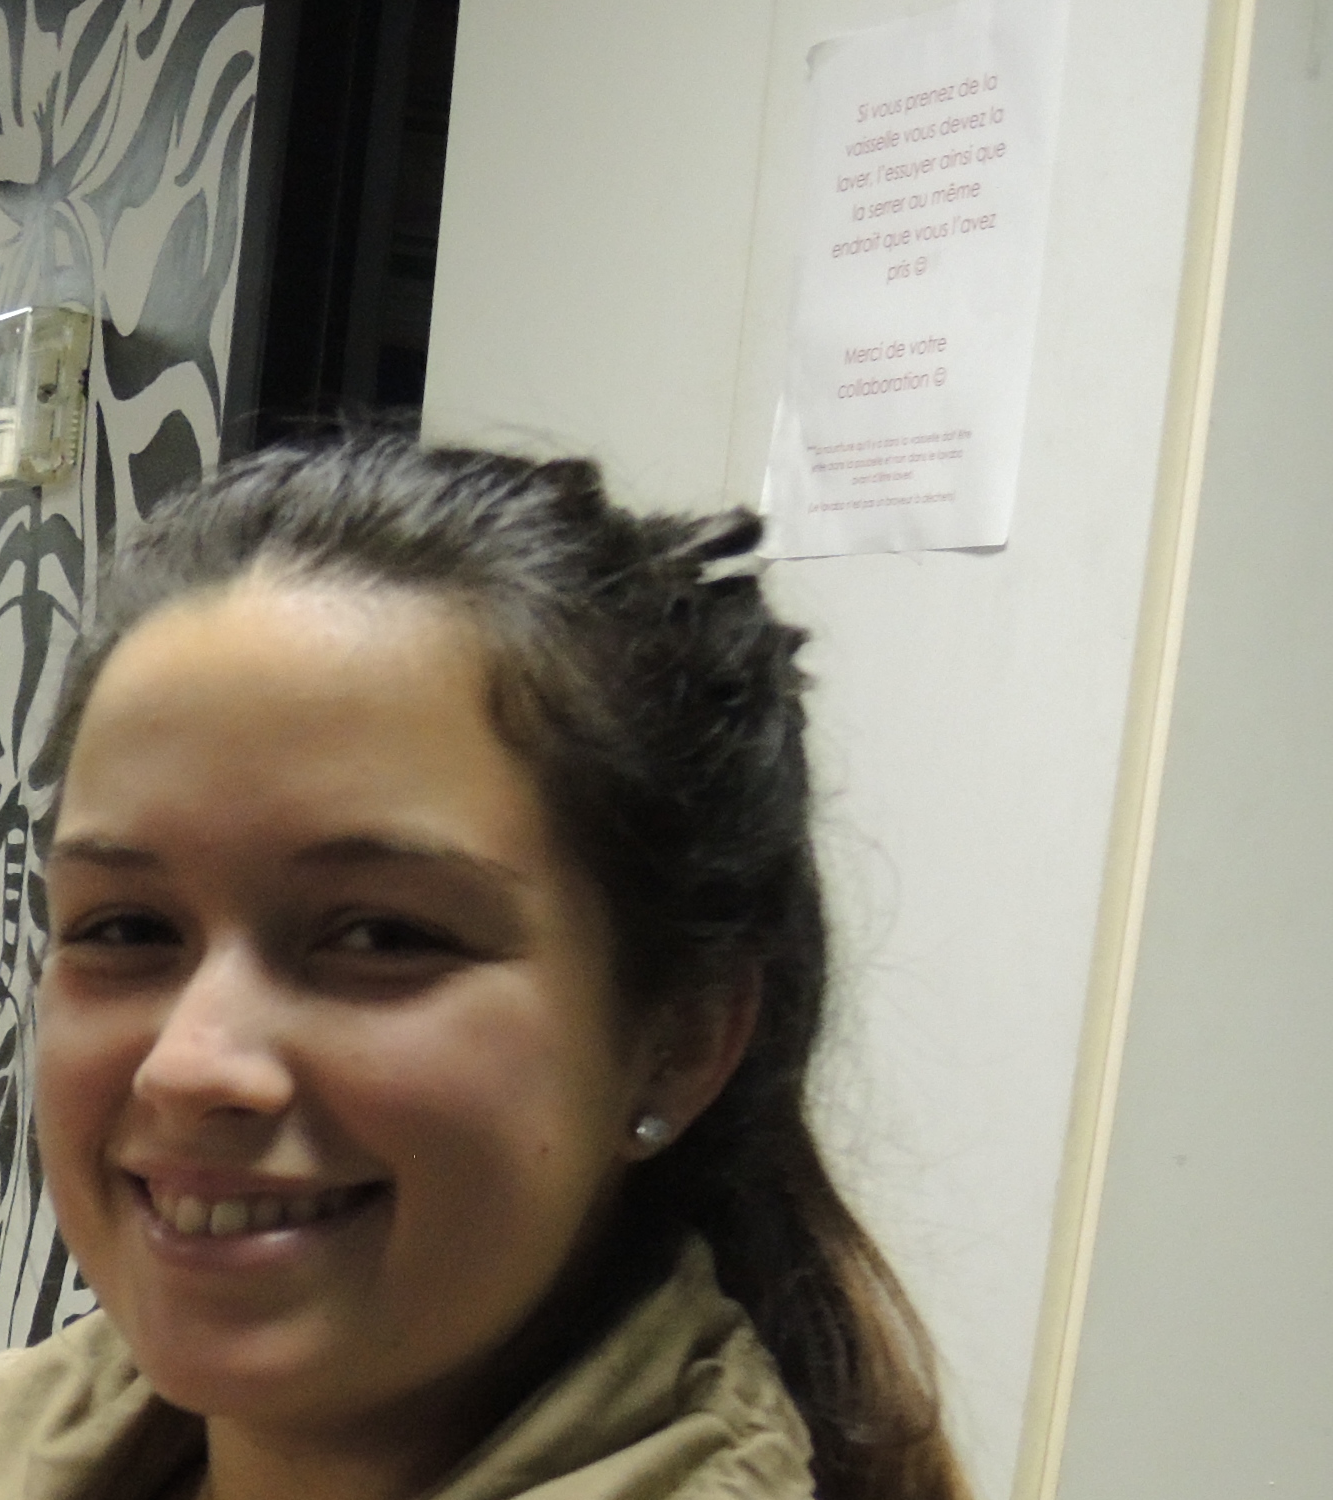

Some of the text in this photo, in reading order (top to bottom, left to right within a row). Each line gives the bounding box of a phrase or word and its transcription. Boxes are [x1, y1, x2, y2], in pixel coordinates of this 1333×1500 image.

[872, 100, 902, 118] vous
[904, 85, 954, 115] prenez
[958, 77, 979, 98] de
[845, 131, 900, 157] vaisselle
[903, 124, 936, 143] vous
[940, 112, 986, 136] devez
[940, 147, 973, 170] ainsi
[975, 141, 1007, 165] que
[909, 194, 927, 211] au
[932, 181, 981, 205] même
[883, 228, 910, 252] que
[915, 221, 948, 242] vous
[843, 334, 947, 365] Merci de votre
[837, 370, 929, 400] collaboration
